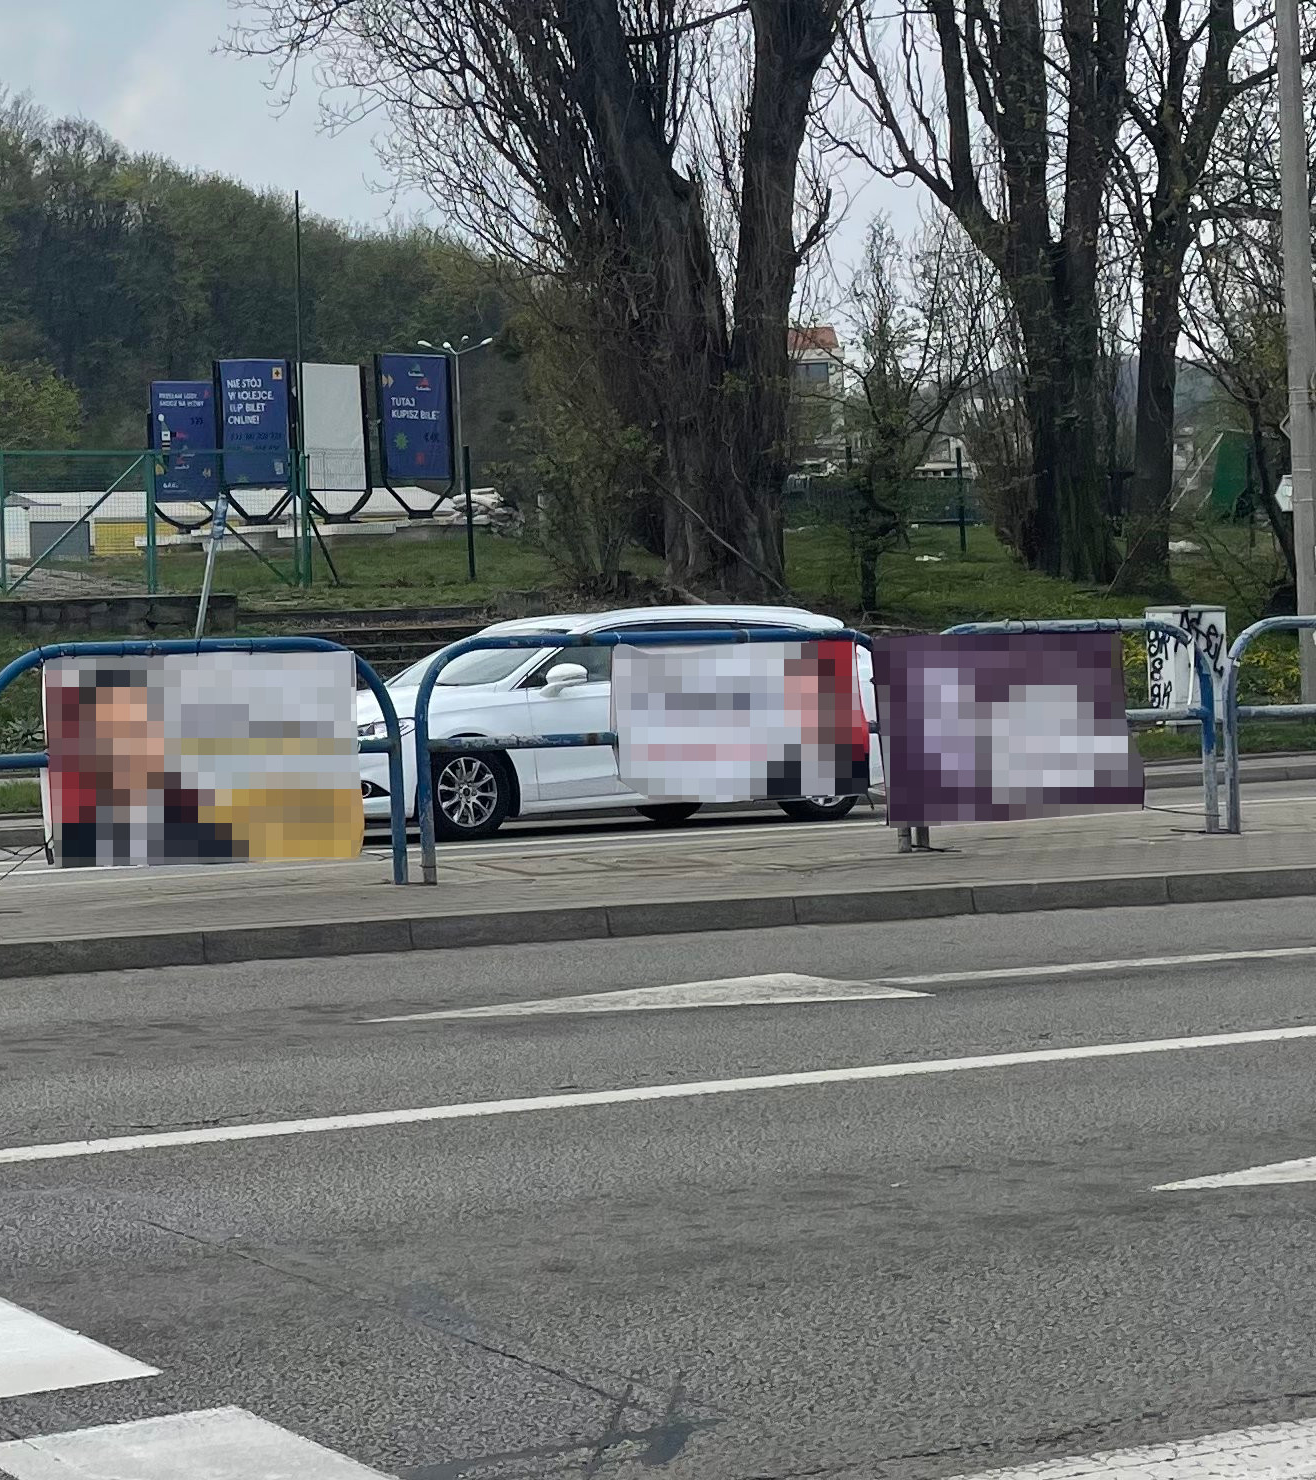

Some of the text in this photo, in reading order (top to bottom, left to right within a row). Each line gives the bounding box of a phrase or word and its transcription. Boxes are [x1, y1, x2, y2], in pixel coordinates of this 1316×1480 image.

[226, 376, 262, 388] NIE STÓJ
[390, 396, 416, 407] TUTAJ
[391, 409, 419, 420] KUPISZ
